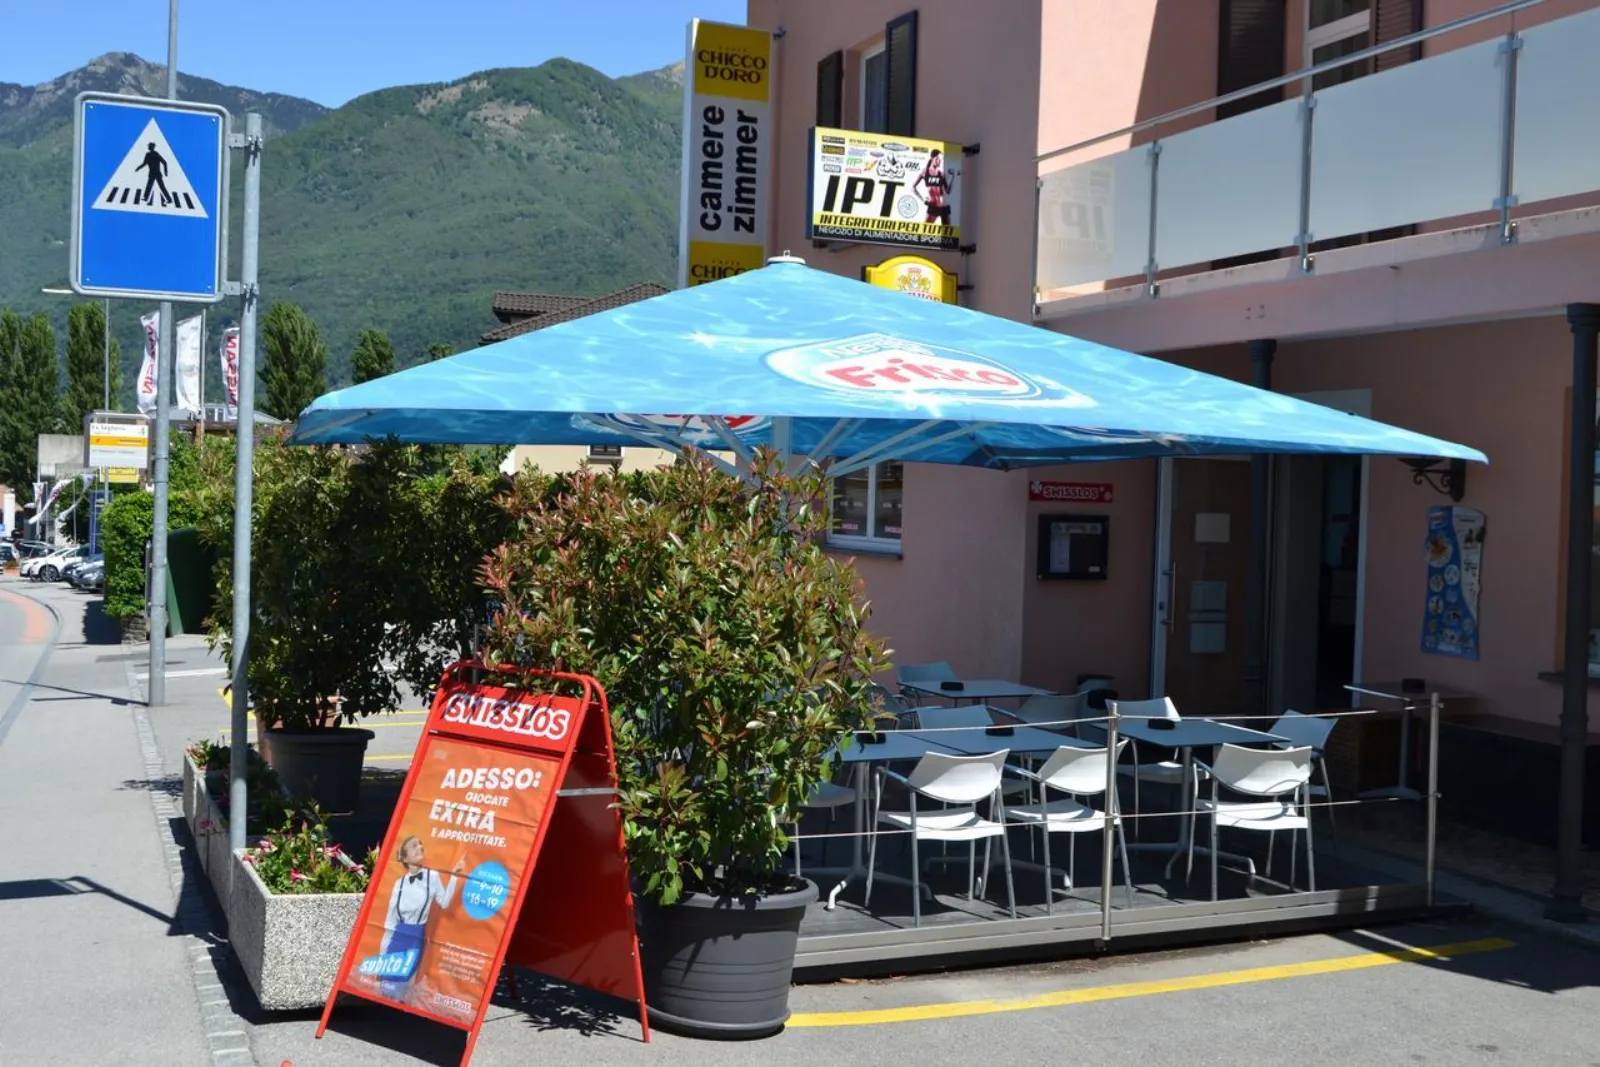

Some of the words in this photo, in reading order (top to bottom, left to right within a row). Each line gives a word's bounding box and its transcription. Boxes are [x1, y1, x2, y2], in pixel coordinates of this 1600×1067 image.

[697, 49, 767, 70] CHICCO
[699, 105, 725, 232] camere
[727, 109, 758, 233] zimmer
[822, 175, 905, 218] IPT
[818, 225, 852, 237] NEGOZIO
[854, 228, 863, 237] DI
[863, 229, 919, 242] ALIMENTAZIONE
[820, 214, 896, 230] INTEGRATORI
[897, 221, 919, 232] PER
[922, 223, 954, 236] TUTTI
[691, 263, 749, 280] CHIC
[824, 357, 1021, 388] Frisco
[1042, 485, 1099, 500] SWISSLOS
[444, 693, 571, 740] SWISSLOS
[440, 767, 542, 790] ADESSO:
[465, 791, 510, 808] GIOCATE
[429, 799, 496, 833] EXTRA
[431, 827, 438, 838] E
[438, 829, 507, 848] APPROFITTATE.
